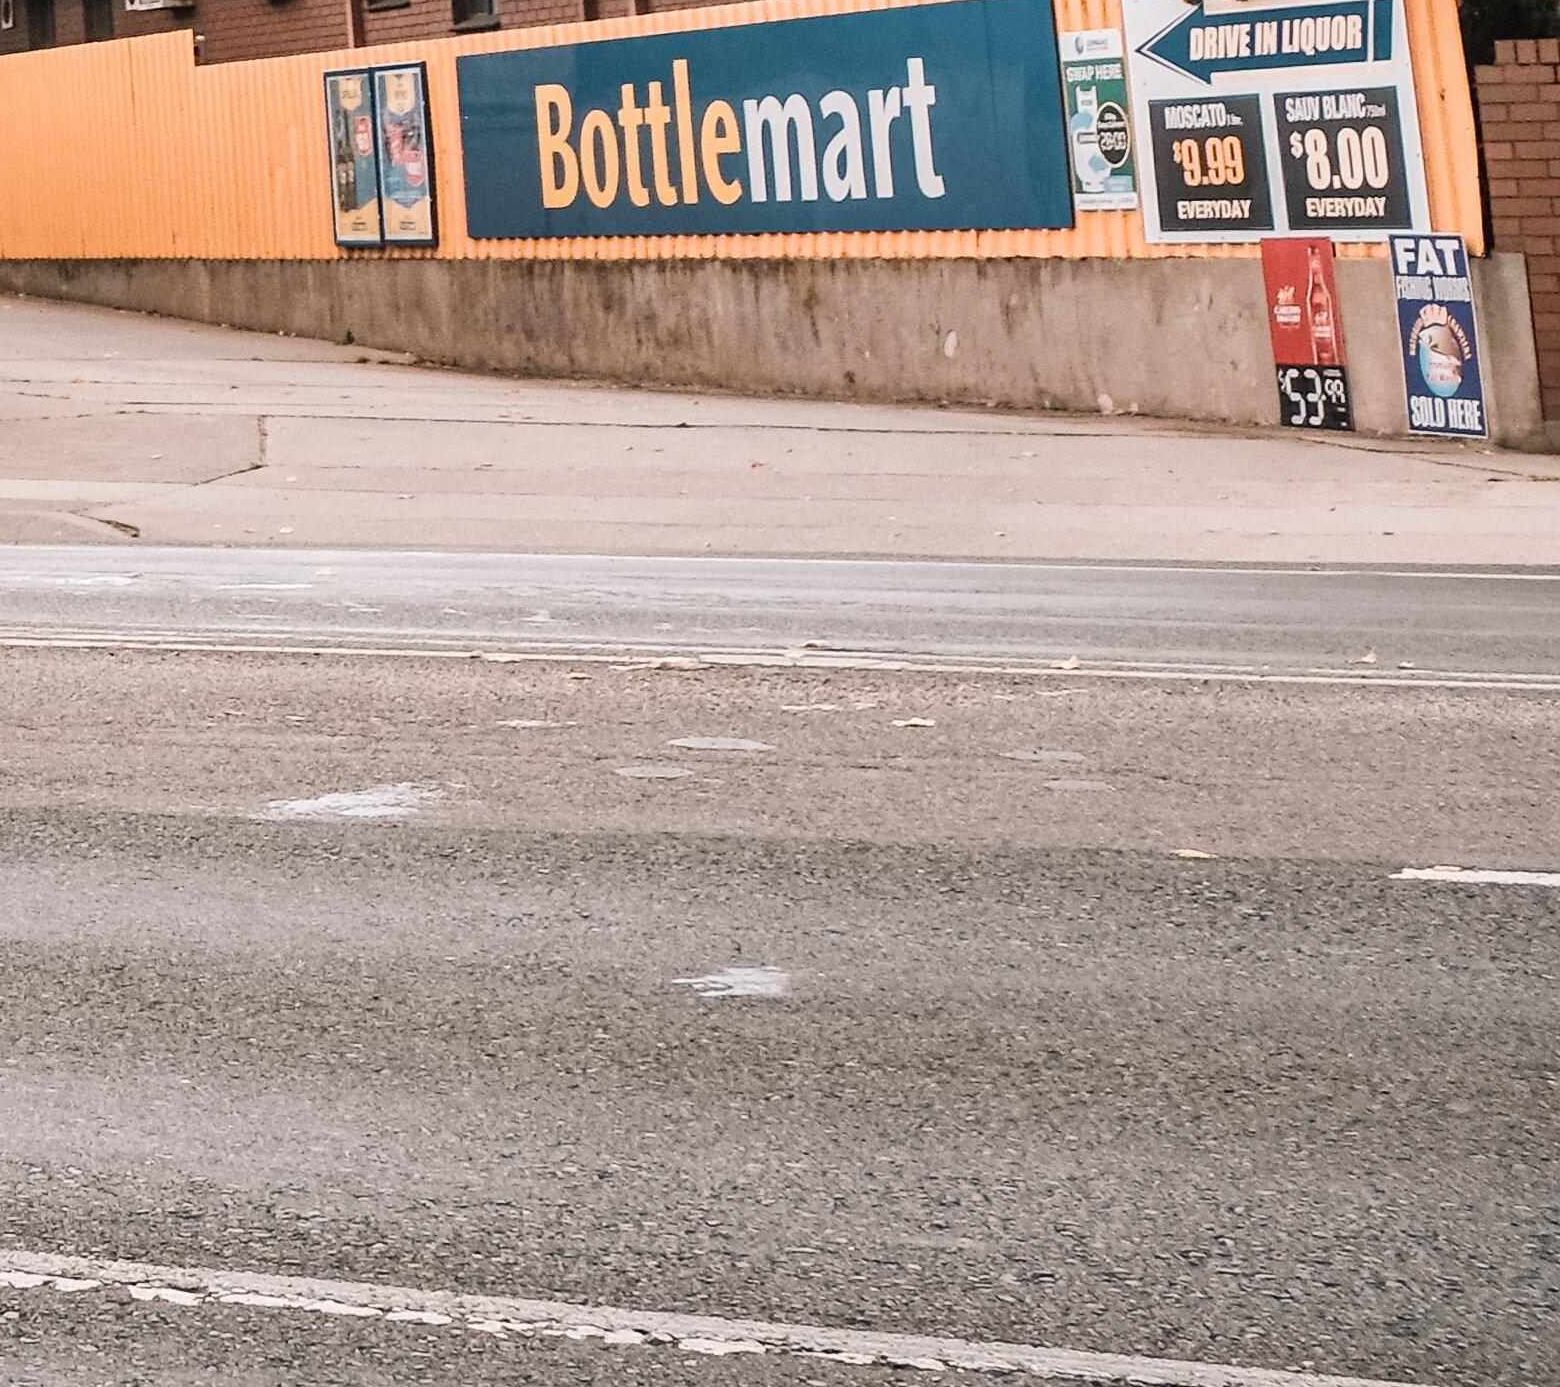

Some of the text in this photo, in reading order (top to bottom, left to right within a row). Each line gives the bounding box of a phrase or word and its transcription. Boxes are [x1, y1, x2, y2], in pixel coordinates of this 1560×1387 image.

[1189, 14, 1363, 62] DRIVE IN LIQUOR
[1163, 102, 1227, 130] MOSCATO
[1284, 96, 1320, 124] SAUV
[1320, 92, 1367, 122] BLANC
[533, 57, 947, 210] Bottlemart
[1176, 198, 1252, 221] EVERYDAY
[1305, 195, 1387, 218] EVERYDAY
[1393, 238, 1461, 276] FAT
[1410, 395, 1483, 431] SOLD HERE
